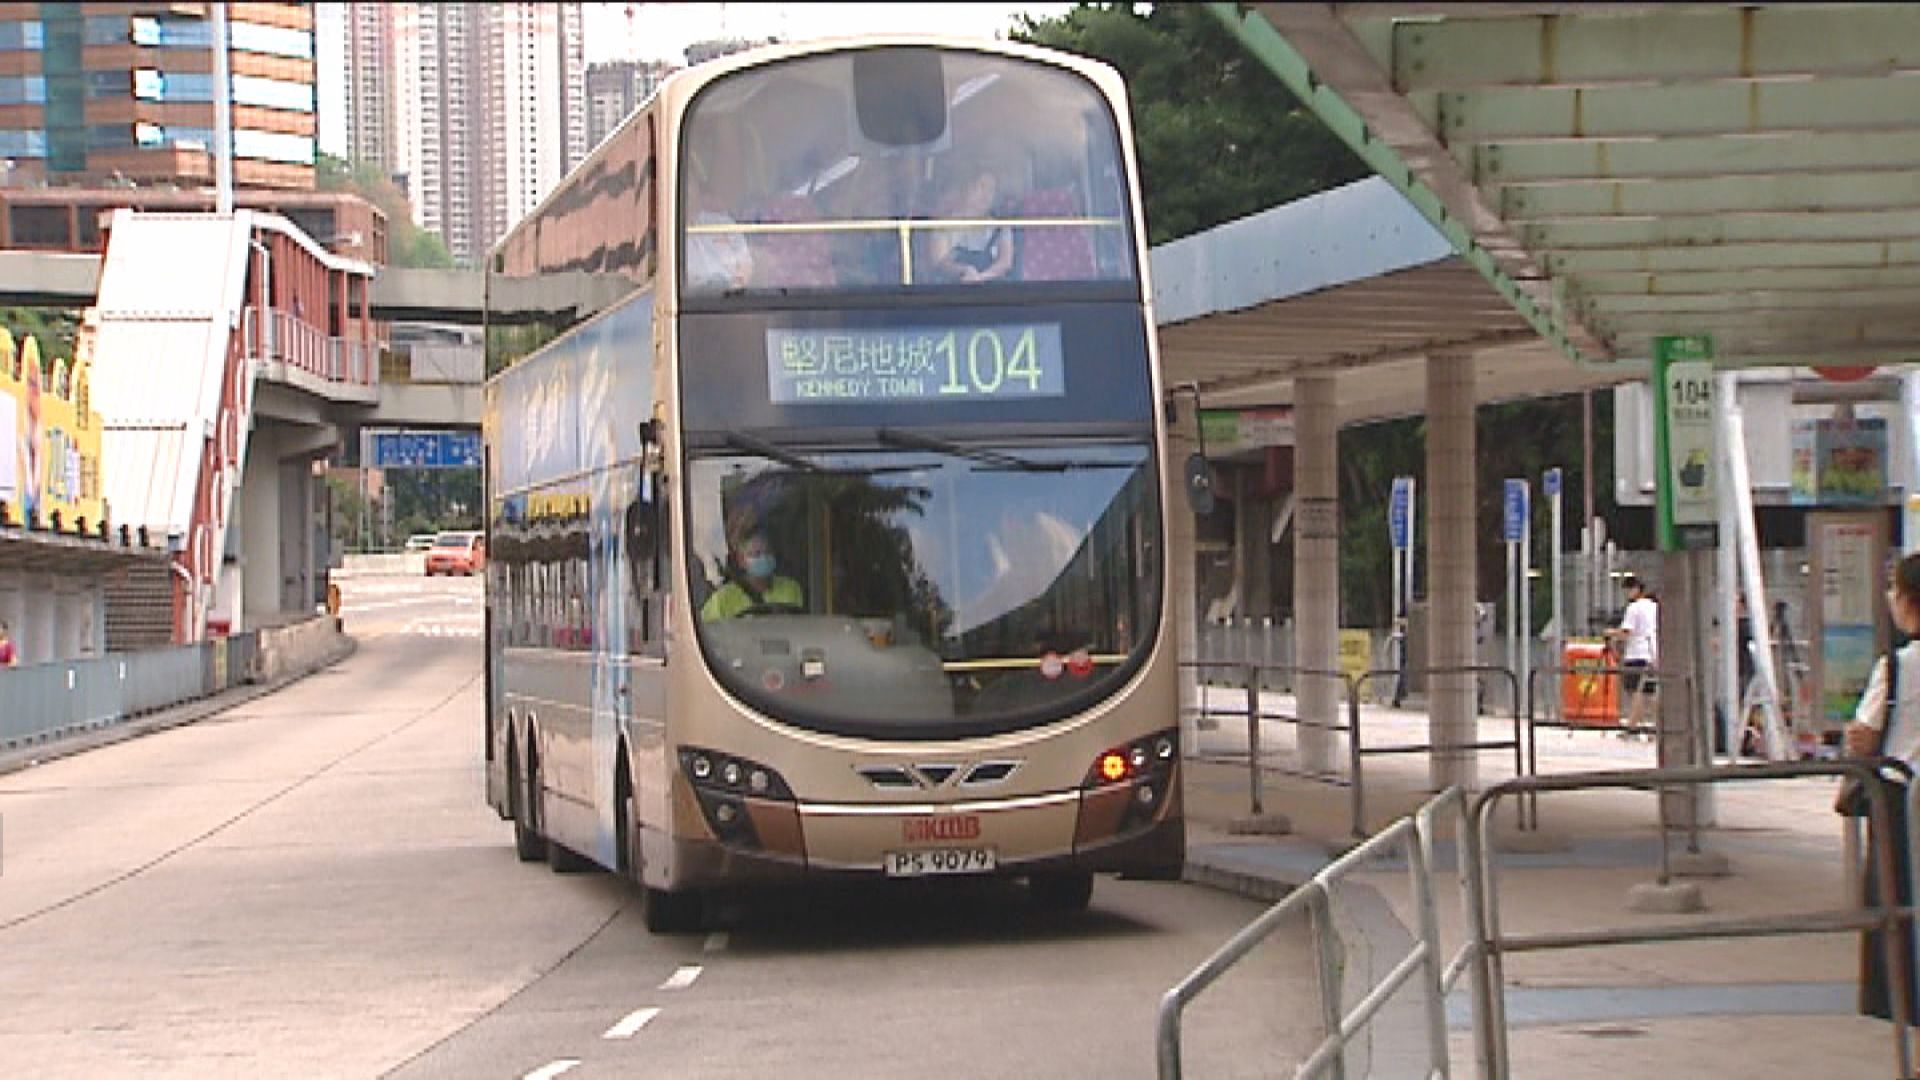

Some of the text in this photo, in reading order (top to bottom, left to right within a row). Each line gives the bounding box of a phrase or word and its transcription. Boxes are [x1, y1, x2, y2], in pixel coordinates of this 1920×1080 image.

[782, 334, 936, 376] 堅尼地城
[936, 328, 1043, 394] 104
[796, 376, 924, 398] KENNEDY TOWN
[1672, 380, 1710, 405] 104
[895, 850, 988, 871] PS 9079
